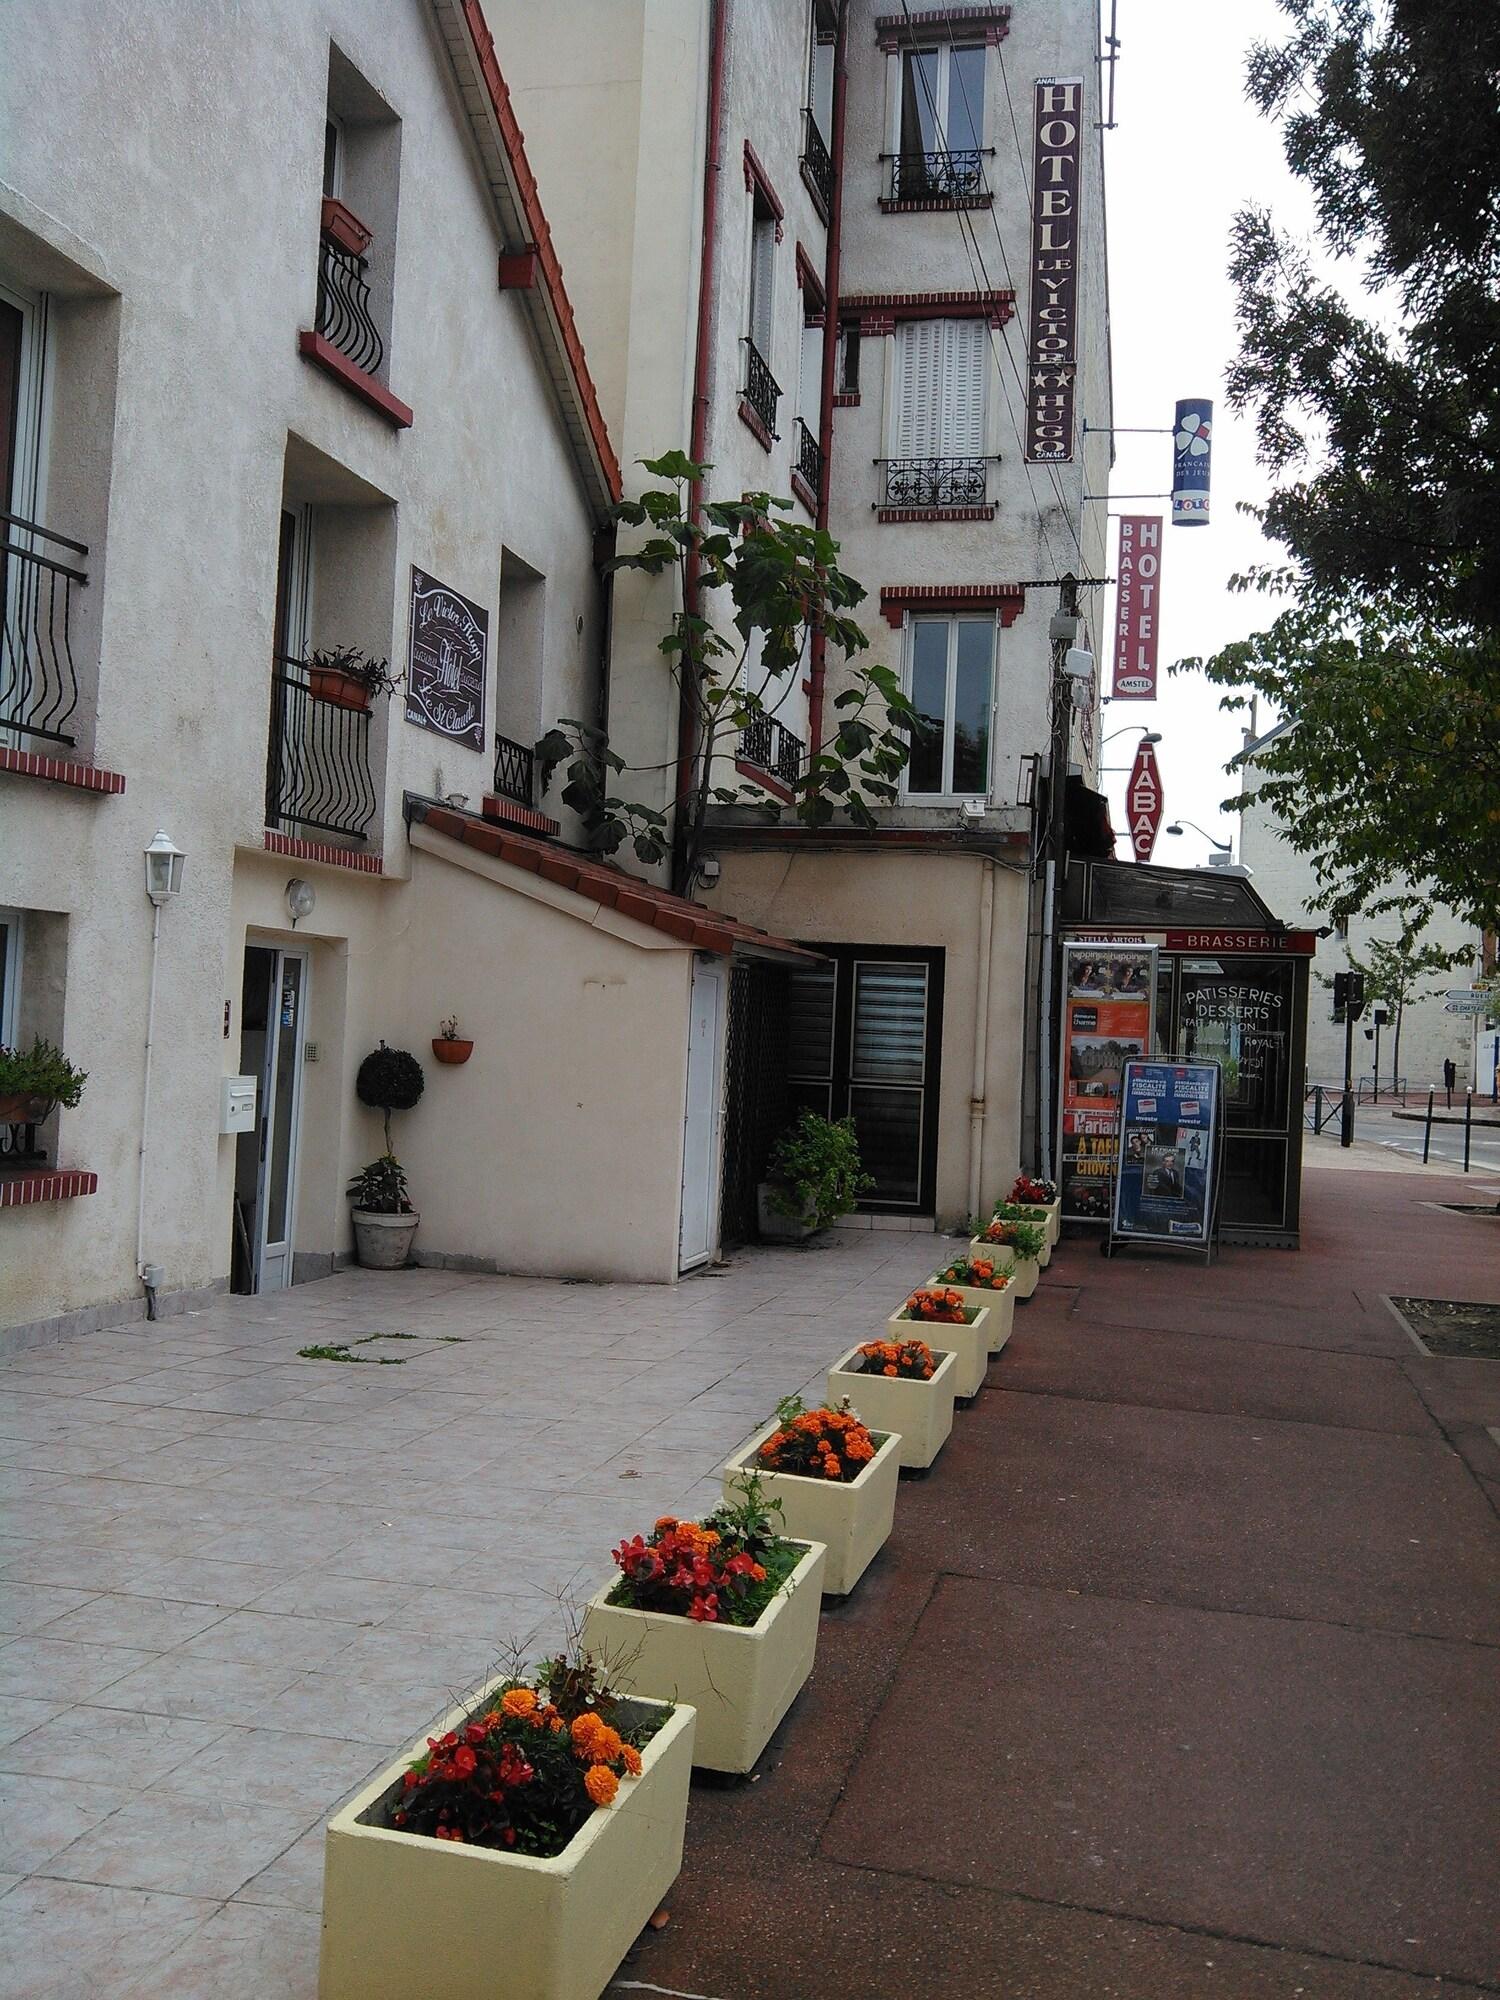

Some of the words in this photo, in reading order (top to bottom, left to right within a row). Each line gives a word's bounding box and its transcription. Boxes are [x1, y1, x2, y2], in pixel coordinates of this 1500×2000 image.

[1039, 86, 1076, 251] HOTEL
[1037, 260, 1072, 270] LE
[1036, 278, 1069, 362] VICTOR
[1033, 394, 1066, 452] HUGO
[1118, 523, 1134, 670] BRASSERIE
[1138, 523, 1158, 671] HOTEL
[419, 601, 433, 629] Le
[433, 595, 460, 624] Victor
[459, 615, 482, 666] Hugo
[1120, 680, 1150, 688] AMSTEL
[406, 709, 428, 725] CANAL+
[433, 704, 445, 725] St
[445, 700, 476, 730] Claude
[1133, 750, 1157, 854] TABAC
[1110, 936, 1143, 944] ARTOIS
[1187, 935, 1288, 949] BRASSERIE
[1185, 986, 1284, 1008] PATISSERIES
[1198, 1005, 1270, 1019] DESSERTS
